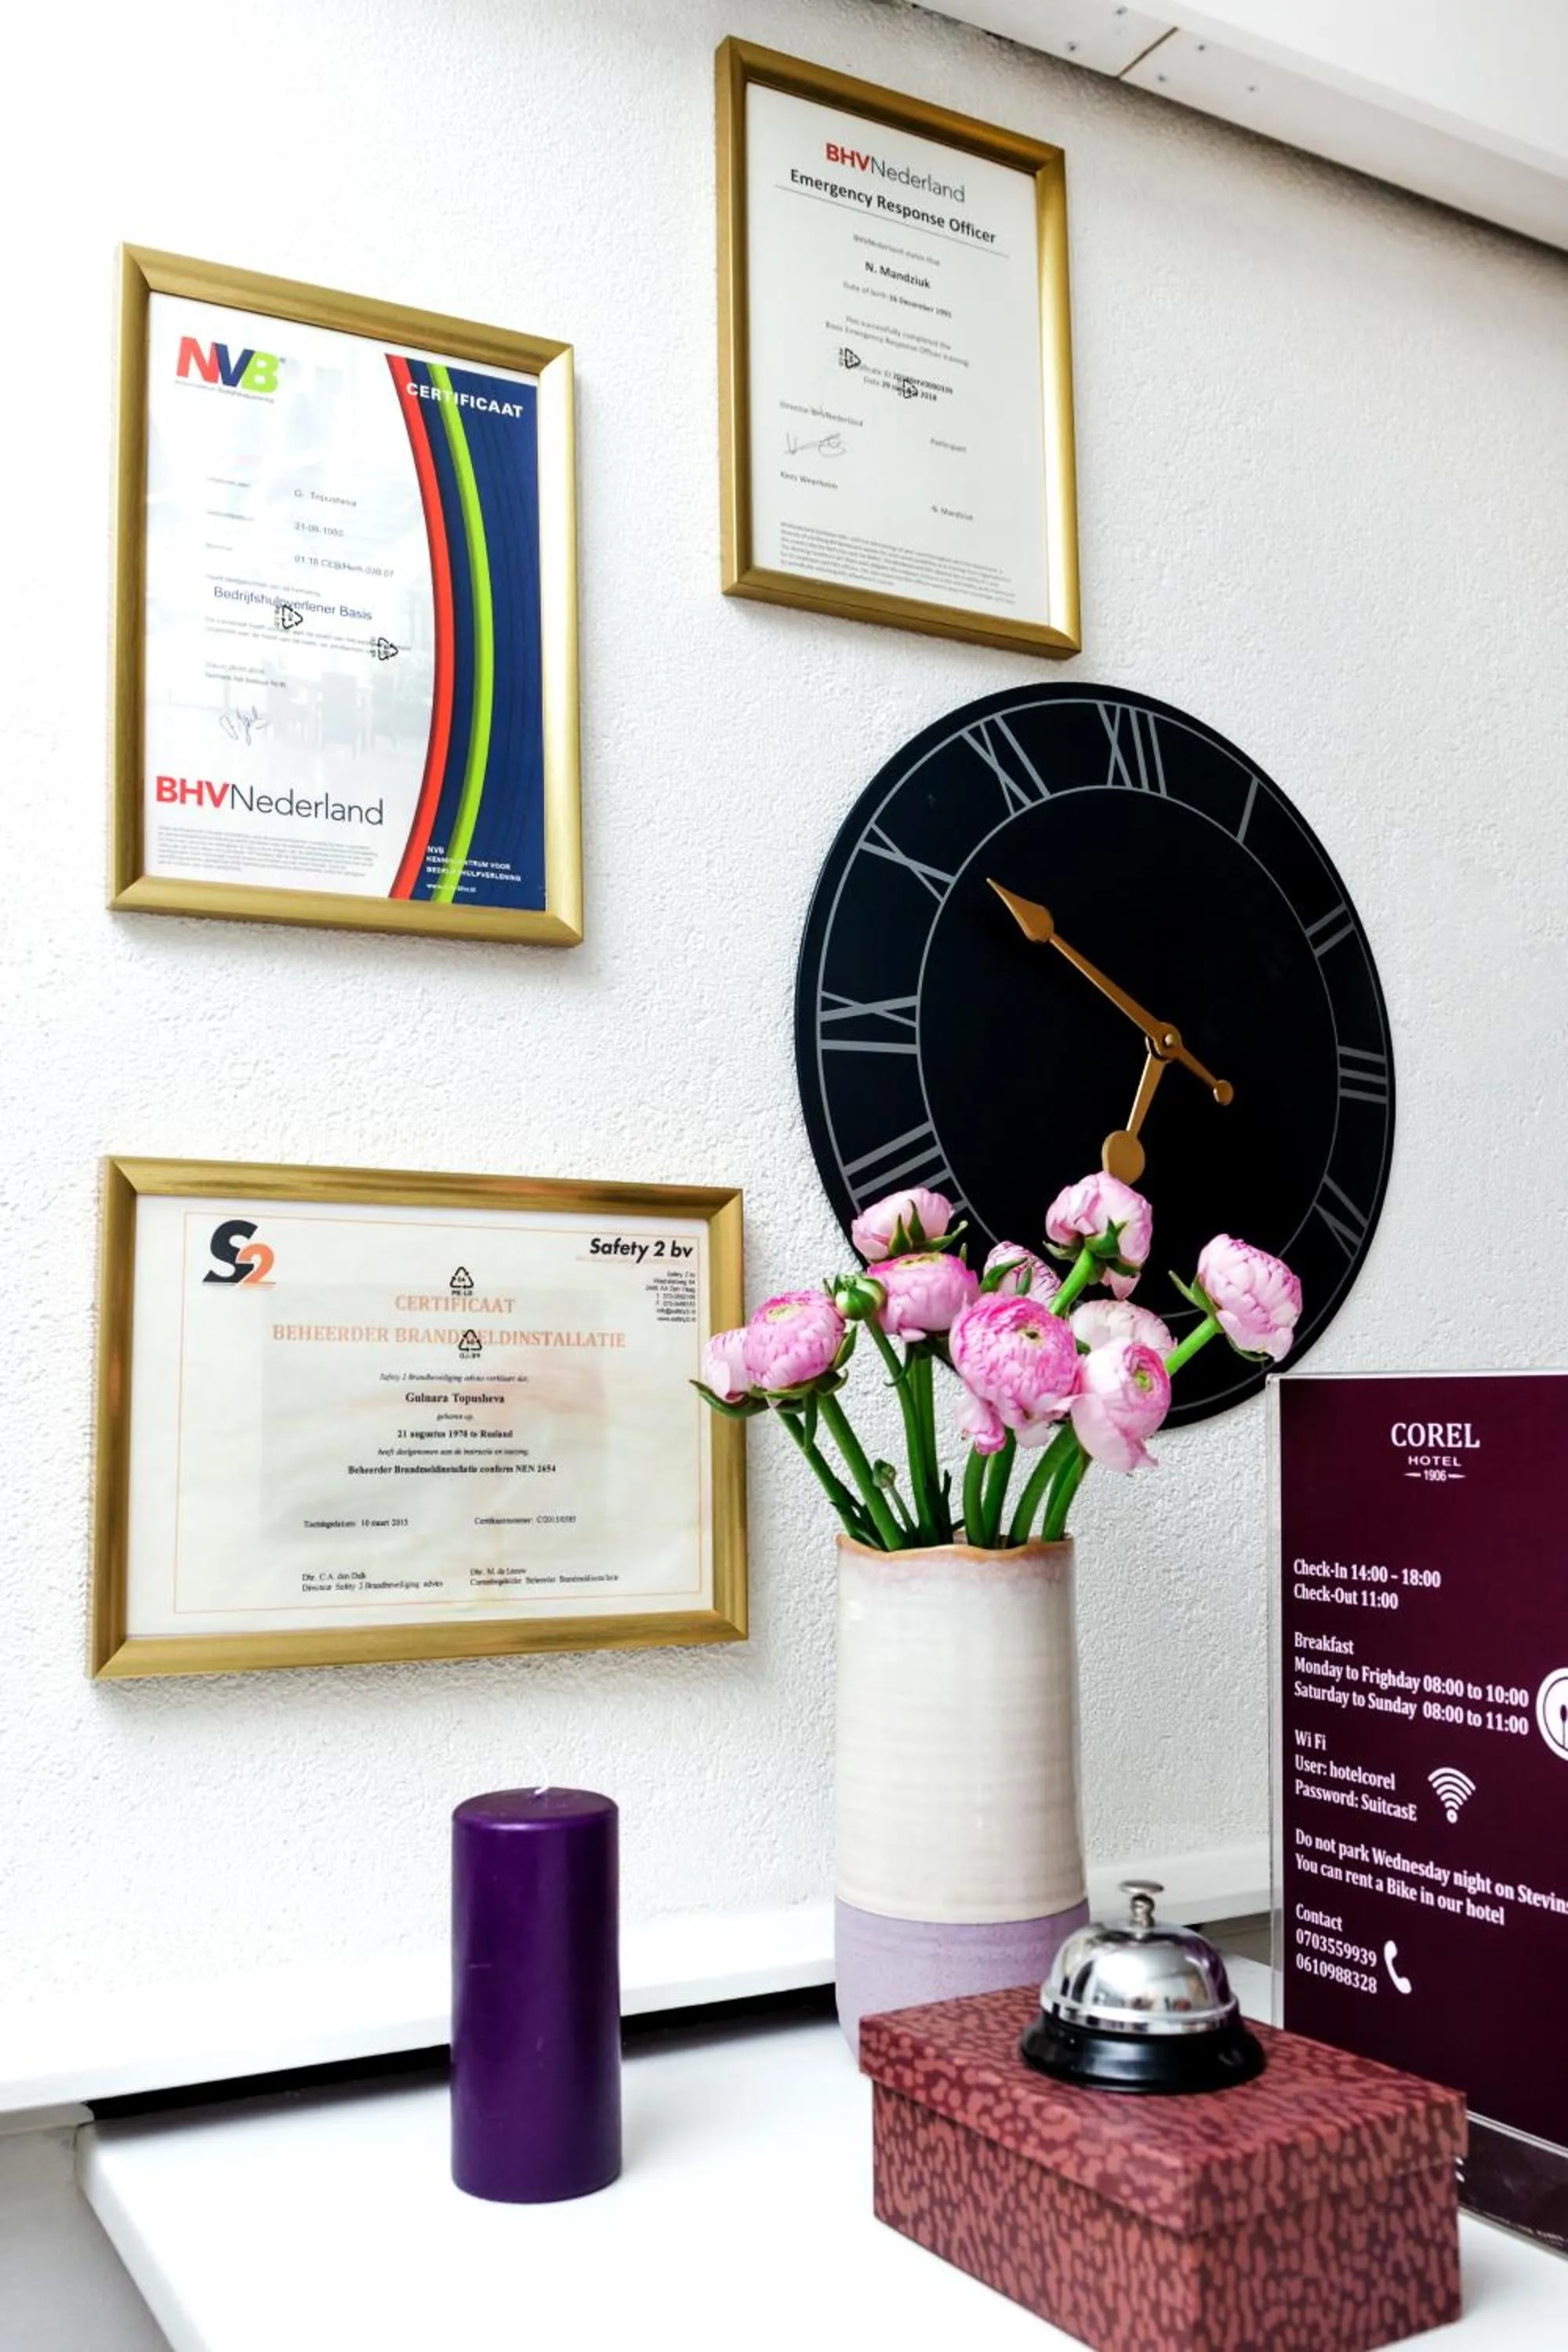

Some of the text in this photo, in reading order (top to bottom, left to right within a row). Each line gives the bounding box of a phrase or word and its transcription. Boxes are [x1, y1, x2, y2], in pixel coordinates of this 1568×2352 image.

[826, 143, 965, 202] BHVNederland
[790, 169, 996, 243] Emergency Response Officer
[865, 261, 931, 289] N. Mandziuk
[406, 383, 523, 418] CERTIFICAAT
[339, 604, 372, 620] Basis
[156, 775, 383, 826] BHVNederland
[590, 1237, 649, 1264] Safety
[653, 1240, 666, 1257] 2
[670, 1240, 694, 1258] bv
[395, 1295, 516, 1313] CERTIFICAAT
[273, 1324, 389, 1343] BEHEERDER
[405, 1392, 505, 1404] Gulnara Topusheva
[1391, 1422, 1480, 1448] COREL
[1407, 1456, 1462, 1466] HOTEL
[1424, 1469, 1446, 1482] 1906
[1294, 1559, 1348, 1579] Check-In
[1351, 1564, 1388, 1583] 14:00
[1402, 1569, 1441, 1588] 18:00
[1294, 1583, 1399, 1609] Check-Out 11:00
[1294, 1631, 1354, 1655] Breakfast
[1294, 1656, 1529, 1708] Monday to Frighday 08:00 to 10:00
[1294, 1681, 1529, 1735] Saturday to Sunday 08:00 to 11:00
[1294, 1729, 1327, 1751] Wi Fi
[1295, 1754, 1396, 1791] User: hotelcorel
[1295, 1779, 1417, 1822] Password: SuitcasE
[1295, 1828, 1312, 1847] Do
[1315, 1837, 1336, 1854] not
[1338, 1842, 1370, 1863] park
[1372, 1847, 1450, 1887] Wednesday
[1453, 1870, 1493, 1895] night
[1494, 1882, 1515, 1900] on
[1295, 1853, 1504, 1926] You can rent a Bike in our hotel
[1296, 1903, 1343, 1933] Contact
[1296, 1928, 1377, 1967] 0703559939
[1296, 1953, 1377, 1994] 0610988328
